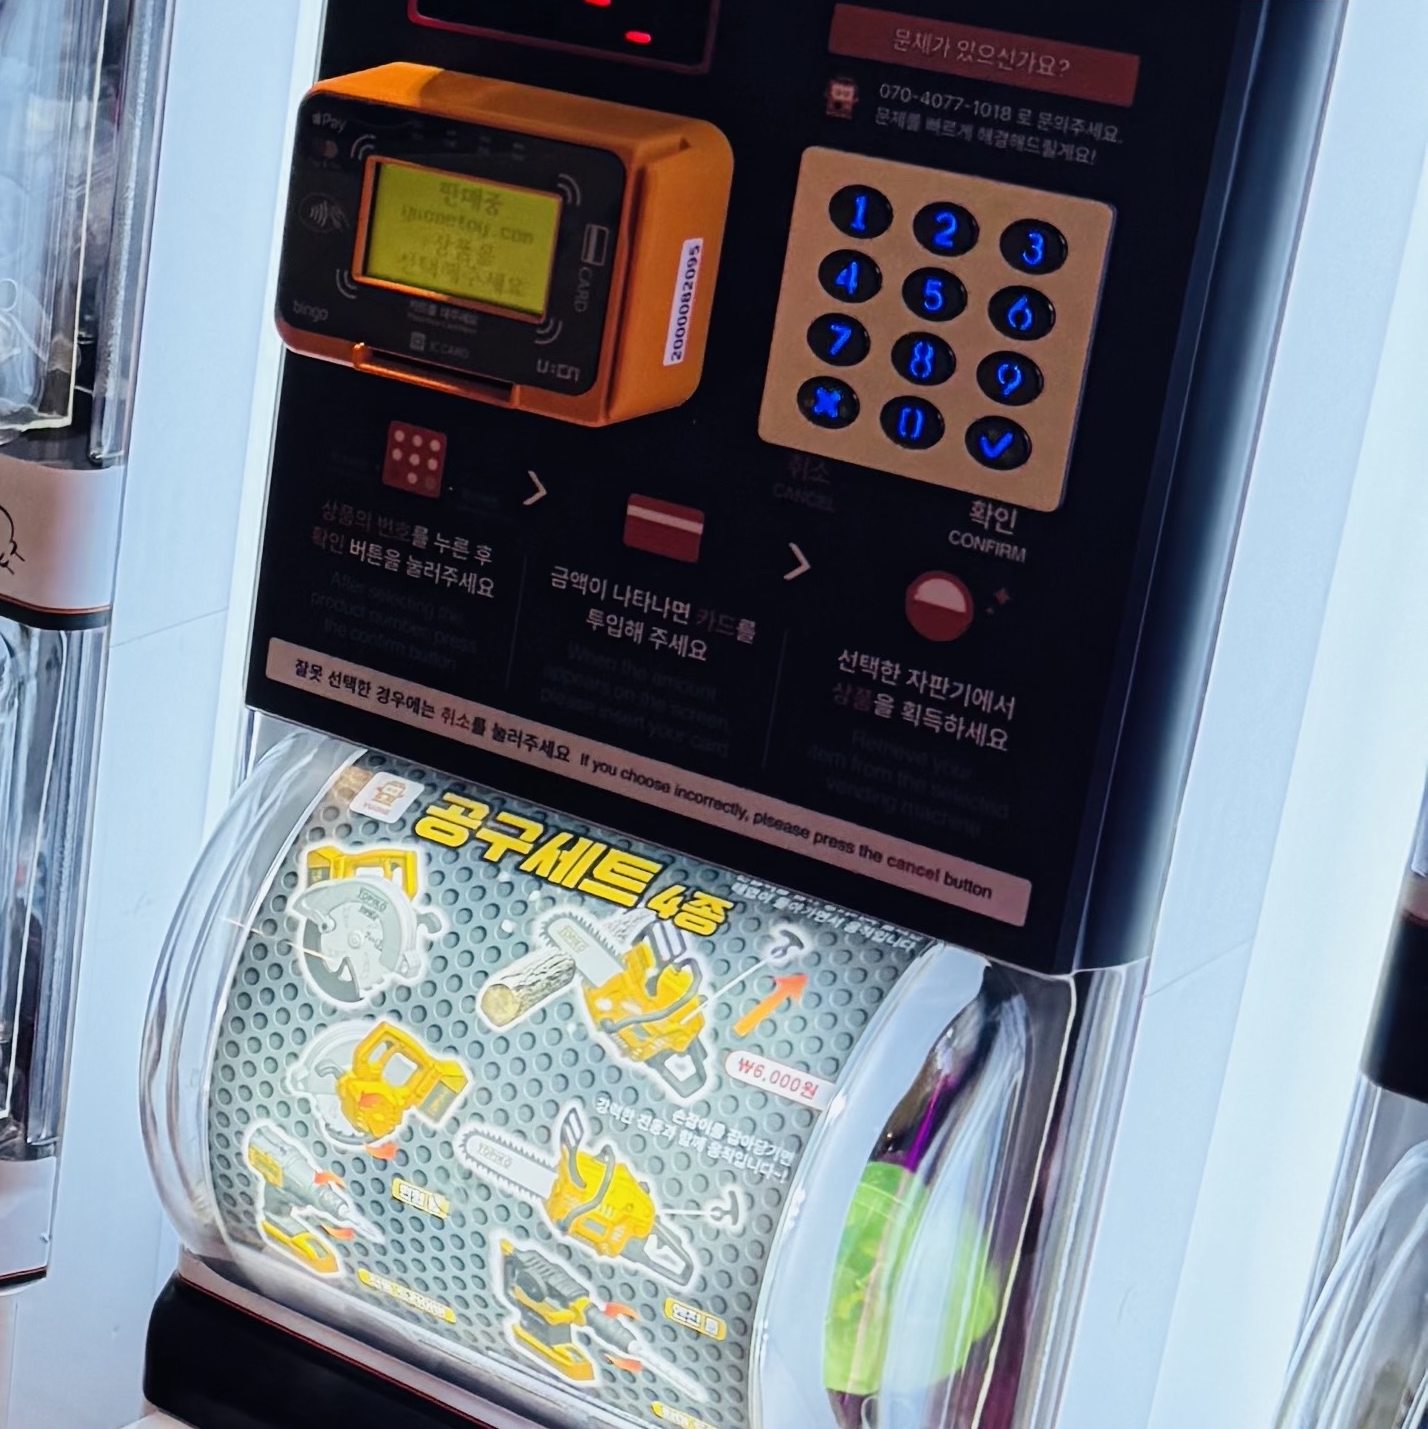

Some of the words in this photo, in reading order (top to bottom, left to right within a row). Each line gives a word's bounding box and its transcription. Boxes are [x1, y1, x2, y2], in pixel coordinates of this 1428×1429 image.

[892, 28, 951, 59] 문제가
[956, 39, 1071, 80] 있으신가요?
[321, 113, 347, 133] Pay
[879, 83, 1012, 123] 070-4077-1018
[1015, 110, 1034, 127] 로
[851, 195, 869, 231] 1
[933, 210, 958, 249] 2
[1022, 230, 1044, 266] 3
[574, 265, 593, 314] CARD
[670, 243, 702, 363] 2000082095
[835, 261, 859, 296] 4
[923, 279, 944, 313] 5
[1007, 294, 1034, 332] 6
[830, 324, 853, 356] 7
[910, 340, 934, 379] 8
[997, 362, 1023, 396] 9
[899, 407, 925, 439] 0
[320, 498, 374, 531] 상품의
[377, 510, 430, 551] 번호를
[433, 531, 472, 563] 누른
[473, 543, 493, 568] 후
[947, 529, 1027, 564] CONFIRM
[968, 500, 1018, 536] 확인
[310, 524, 345, 557] 확인
[348, 538, 401, 573] 버튼을
[404, 551, 496, 600] 눌러주세요
[549, 565, 608, 601] 금액이
[611, 581, 693, 627] 나타나면
[695, 607, 758, 646] 카드를
[585, 607, 645, 648] 투입해
[648, 626, 709, 664] 주세요
[831, 682, 896, 720] 상품을
[901, 700, 1010, 753] 획득하세요
[836, 648, 903, 687] 선택한
[905, 668, 1017, 722] 자판기에서
[295, 658, 323, 684] 잘못
[327, 672, 372, 699] 선택한
[376, 685, 436, 720] 경우에는
[440, 706, 487, 737] 취소를
[491, 722, 571, 763] 눌러주세요
[580, 752, 590, 767] If
[592, 757, 618, 778] you
[619, 766, 672, 795] choose
[674, 782, 751, 823] incorrectly,
[813, 829, 856, 856] press
[858, 842, 884, 864] the
[886, 854, 941, 883] cancel
[942, 870, 993, 900] button
[413, 791, 663, 907] 공구세트
[646, 880, 734, 938] 4종
